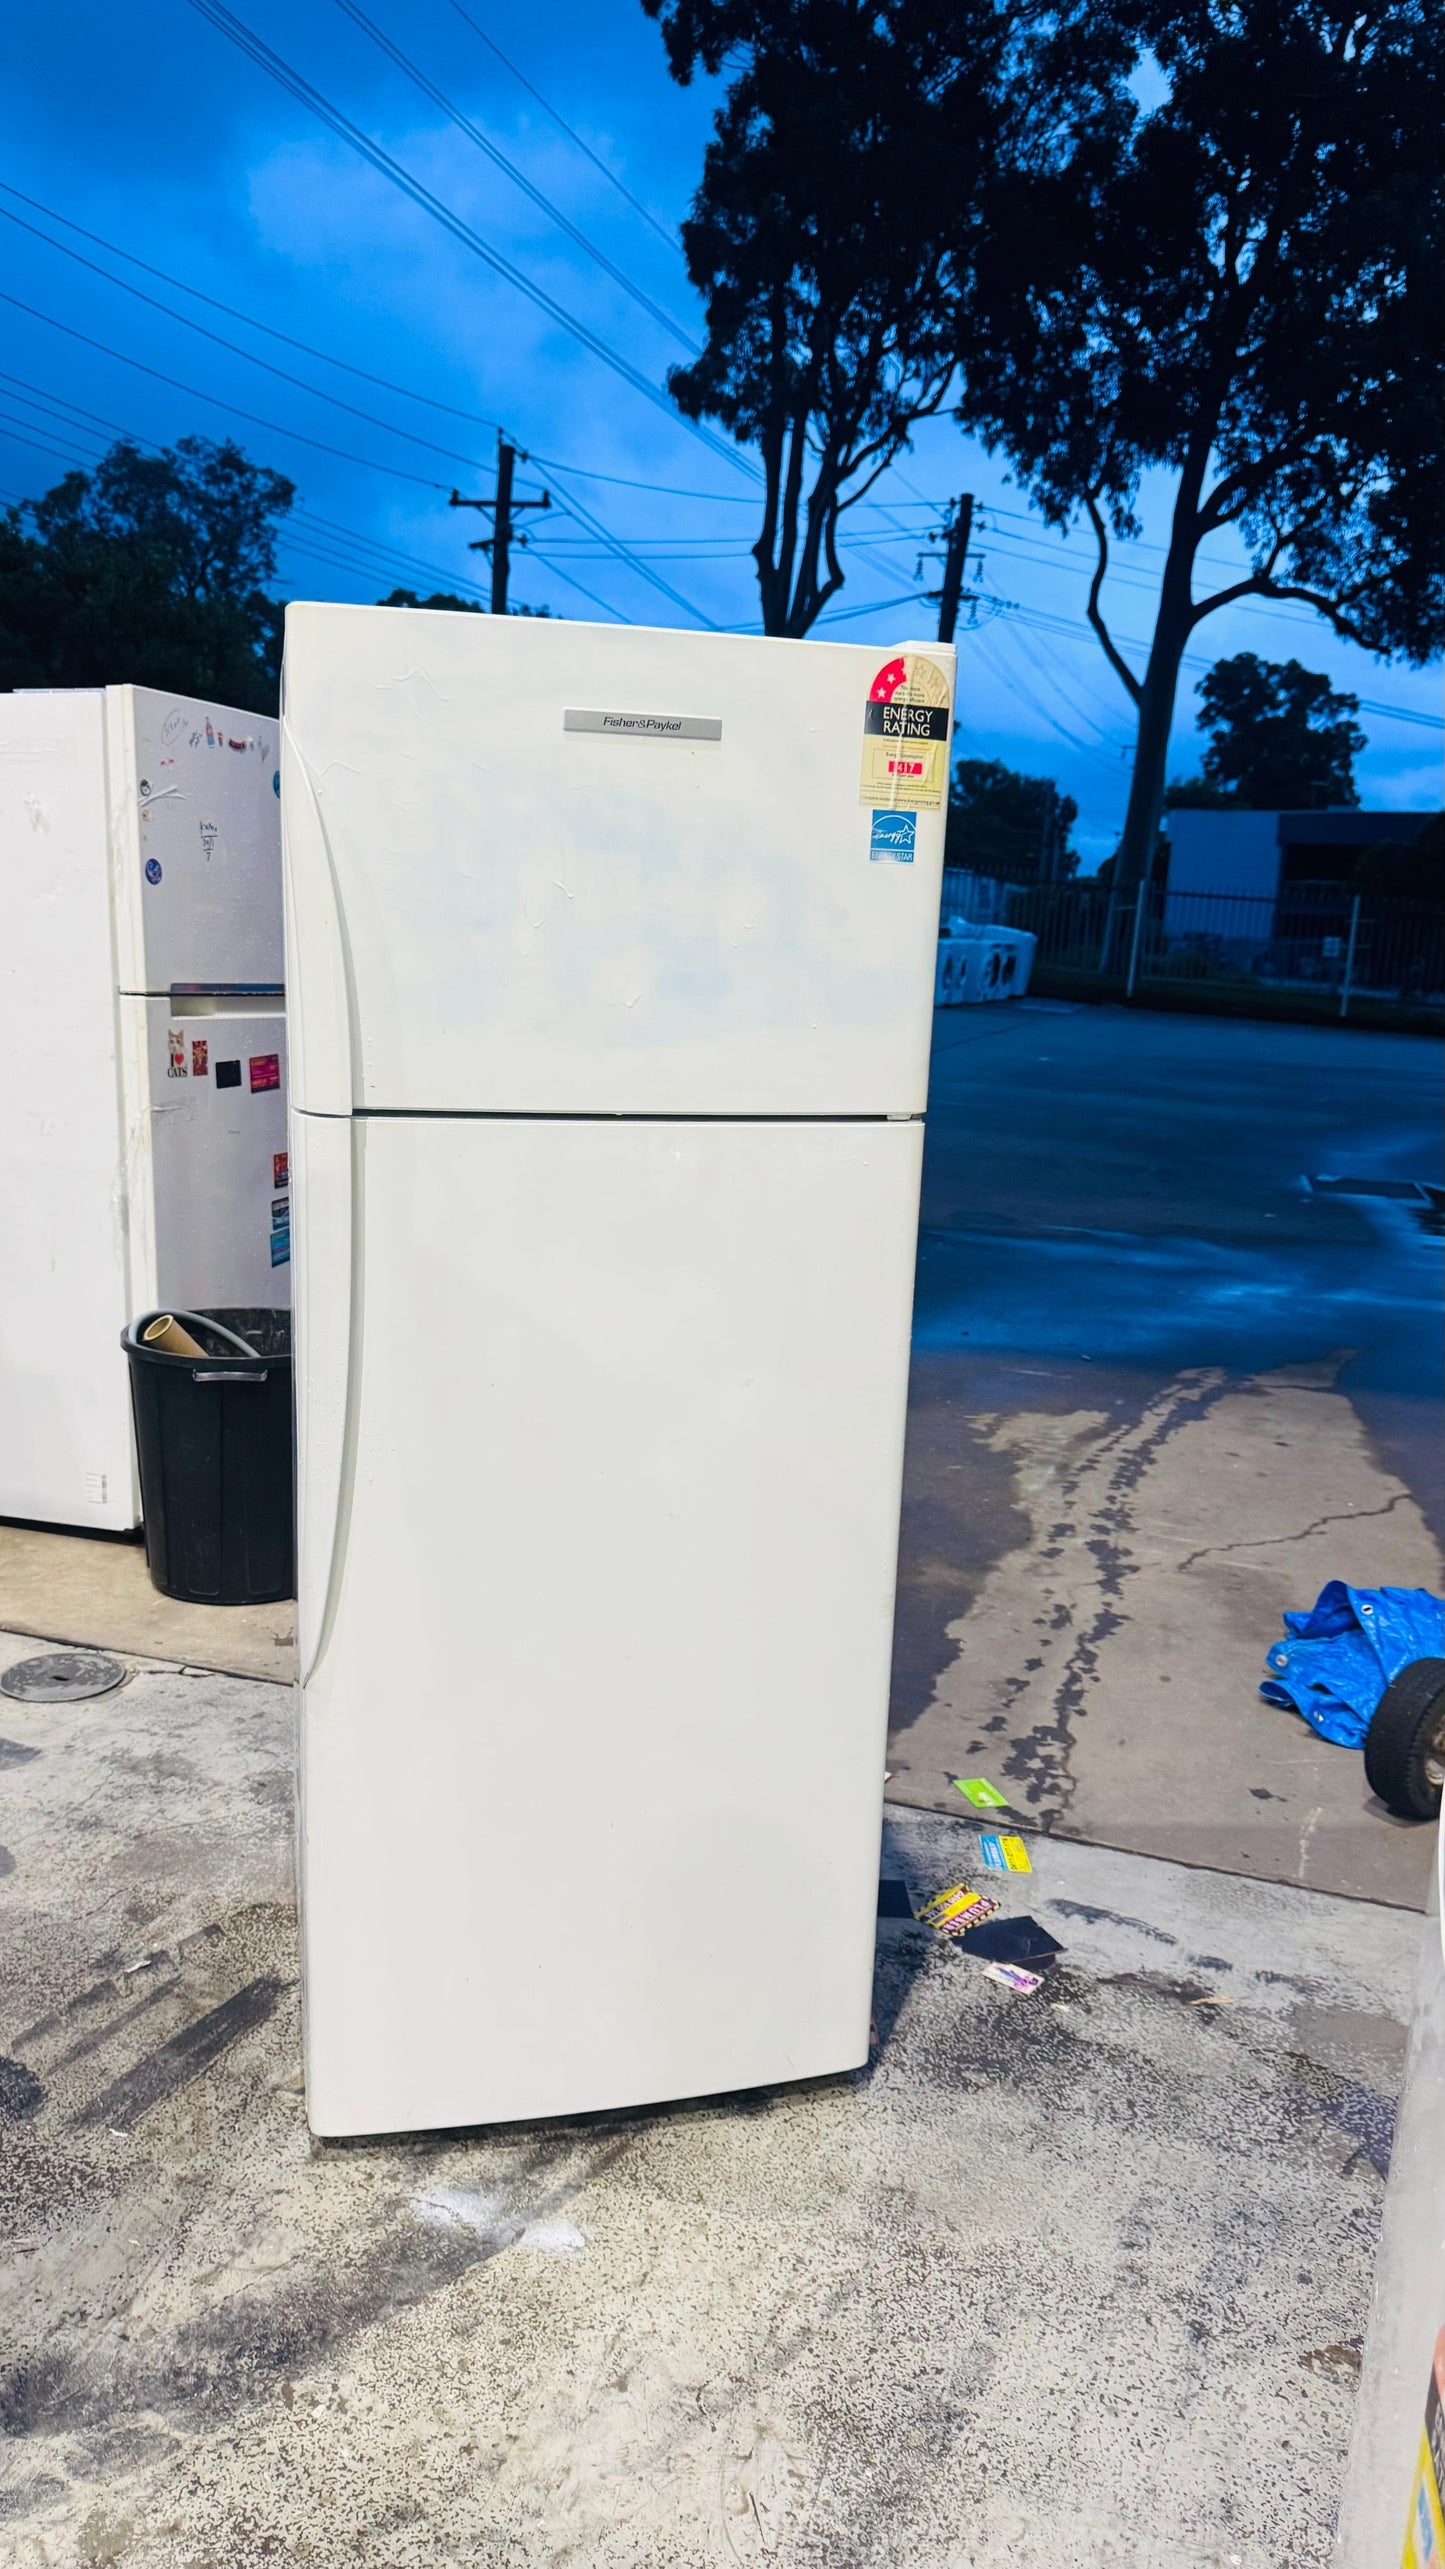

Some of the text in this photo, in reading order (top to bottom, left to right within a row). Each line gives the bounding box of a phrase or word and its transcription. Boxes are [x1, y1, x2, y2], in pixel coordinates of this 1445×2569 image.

[883, 706, 934, 723] ENERGY
[603, 716, 682, 732] Fisher&Paykel
[883, 720, 931, 737] RATING
[871, 851, 913, 862] ENY STAR
[170, 1053, 175, 1068] I
[167, 1067, 188, 1078] CATS
[942, 1899, 992, 1931] PLUMBER
